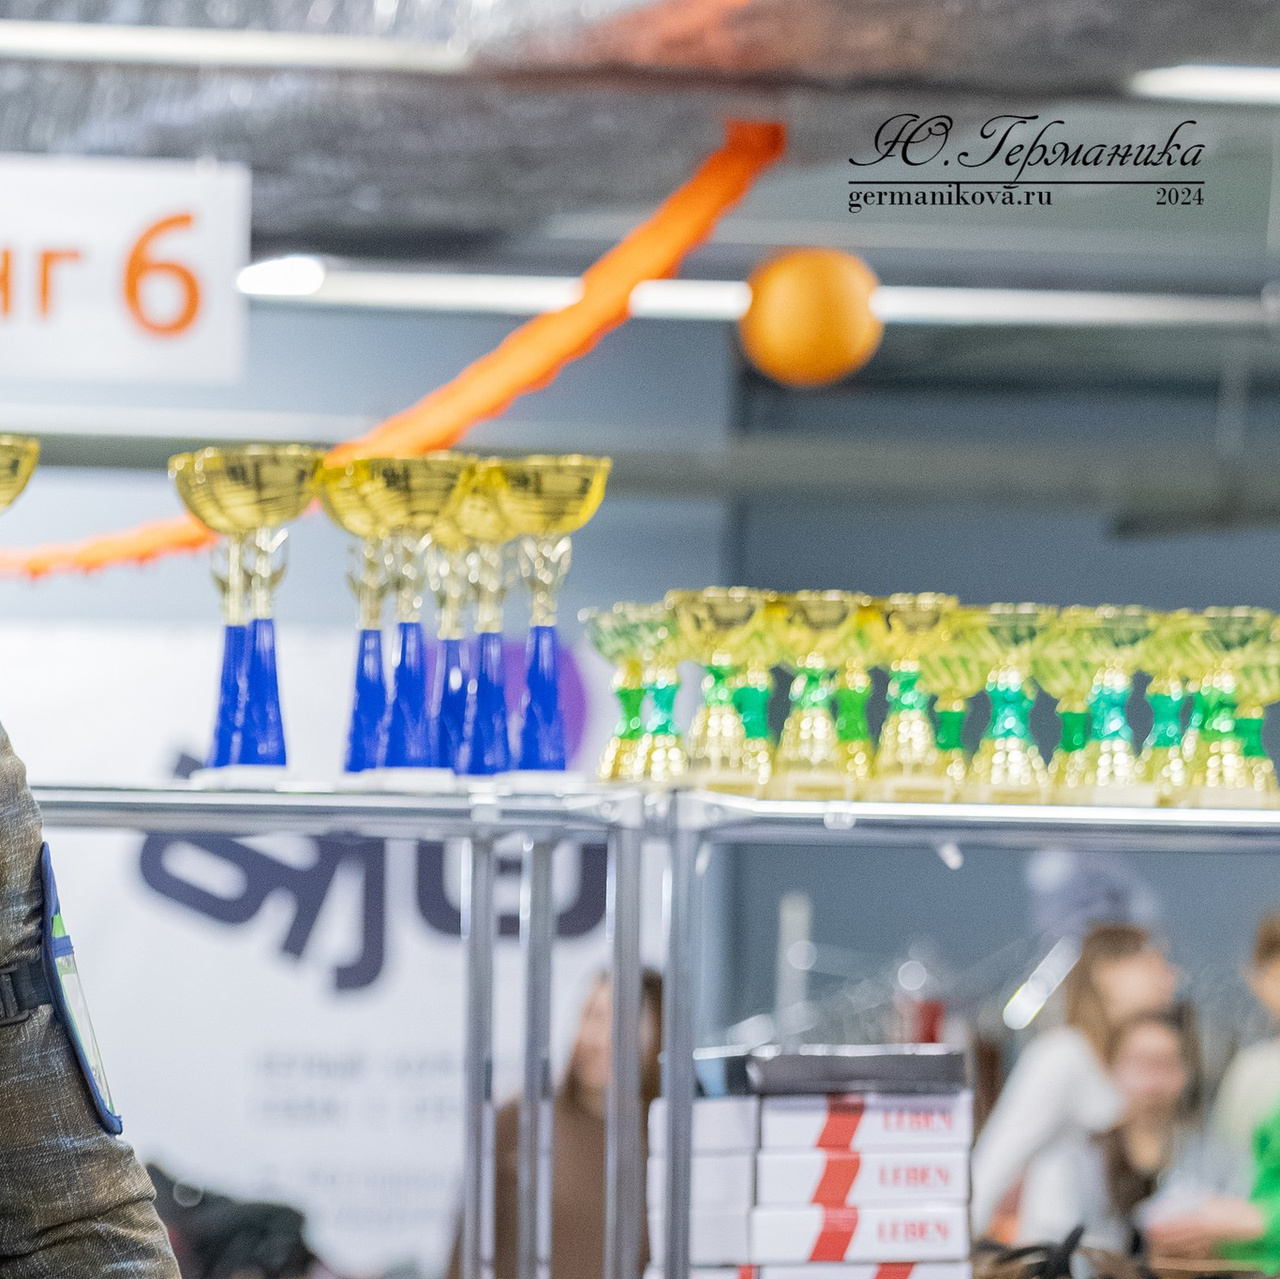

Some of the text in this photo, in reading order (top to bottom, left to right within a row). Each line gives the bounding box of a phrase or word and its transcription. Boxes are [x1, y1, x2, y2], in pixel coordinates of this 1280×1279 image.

[123, 211, 202, 339] 6
[878, 1165, 951, 1187] LEBEN
[877, 1220, 950, 1242] LEBEN
